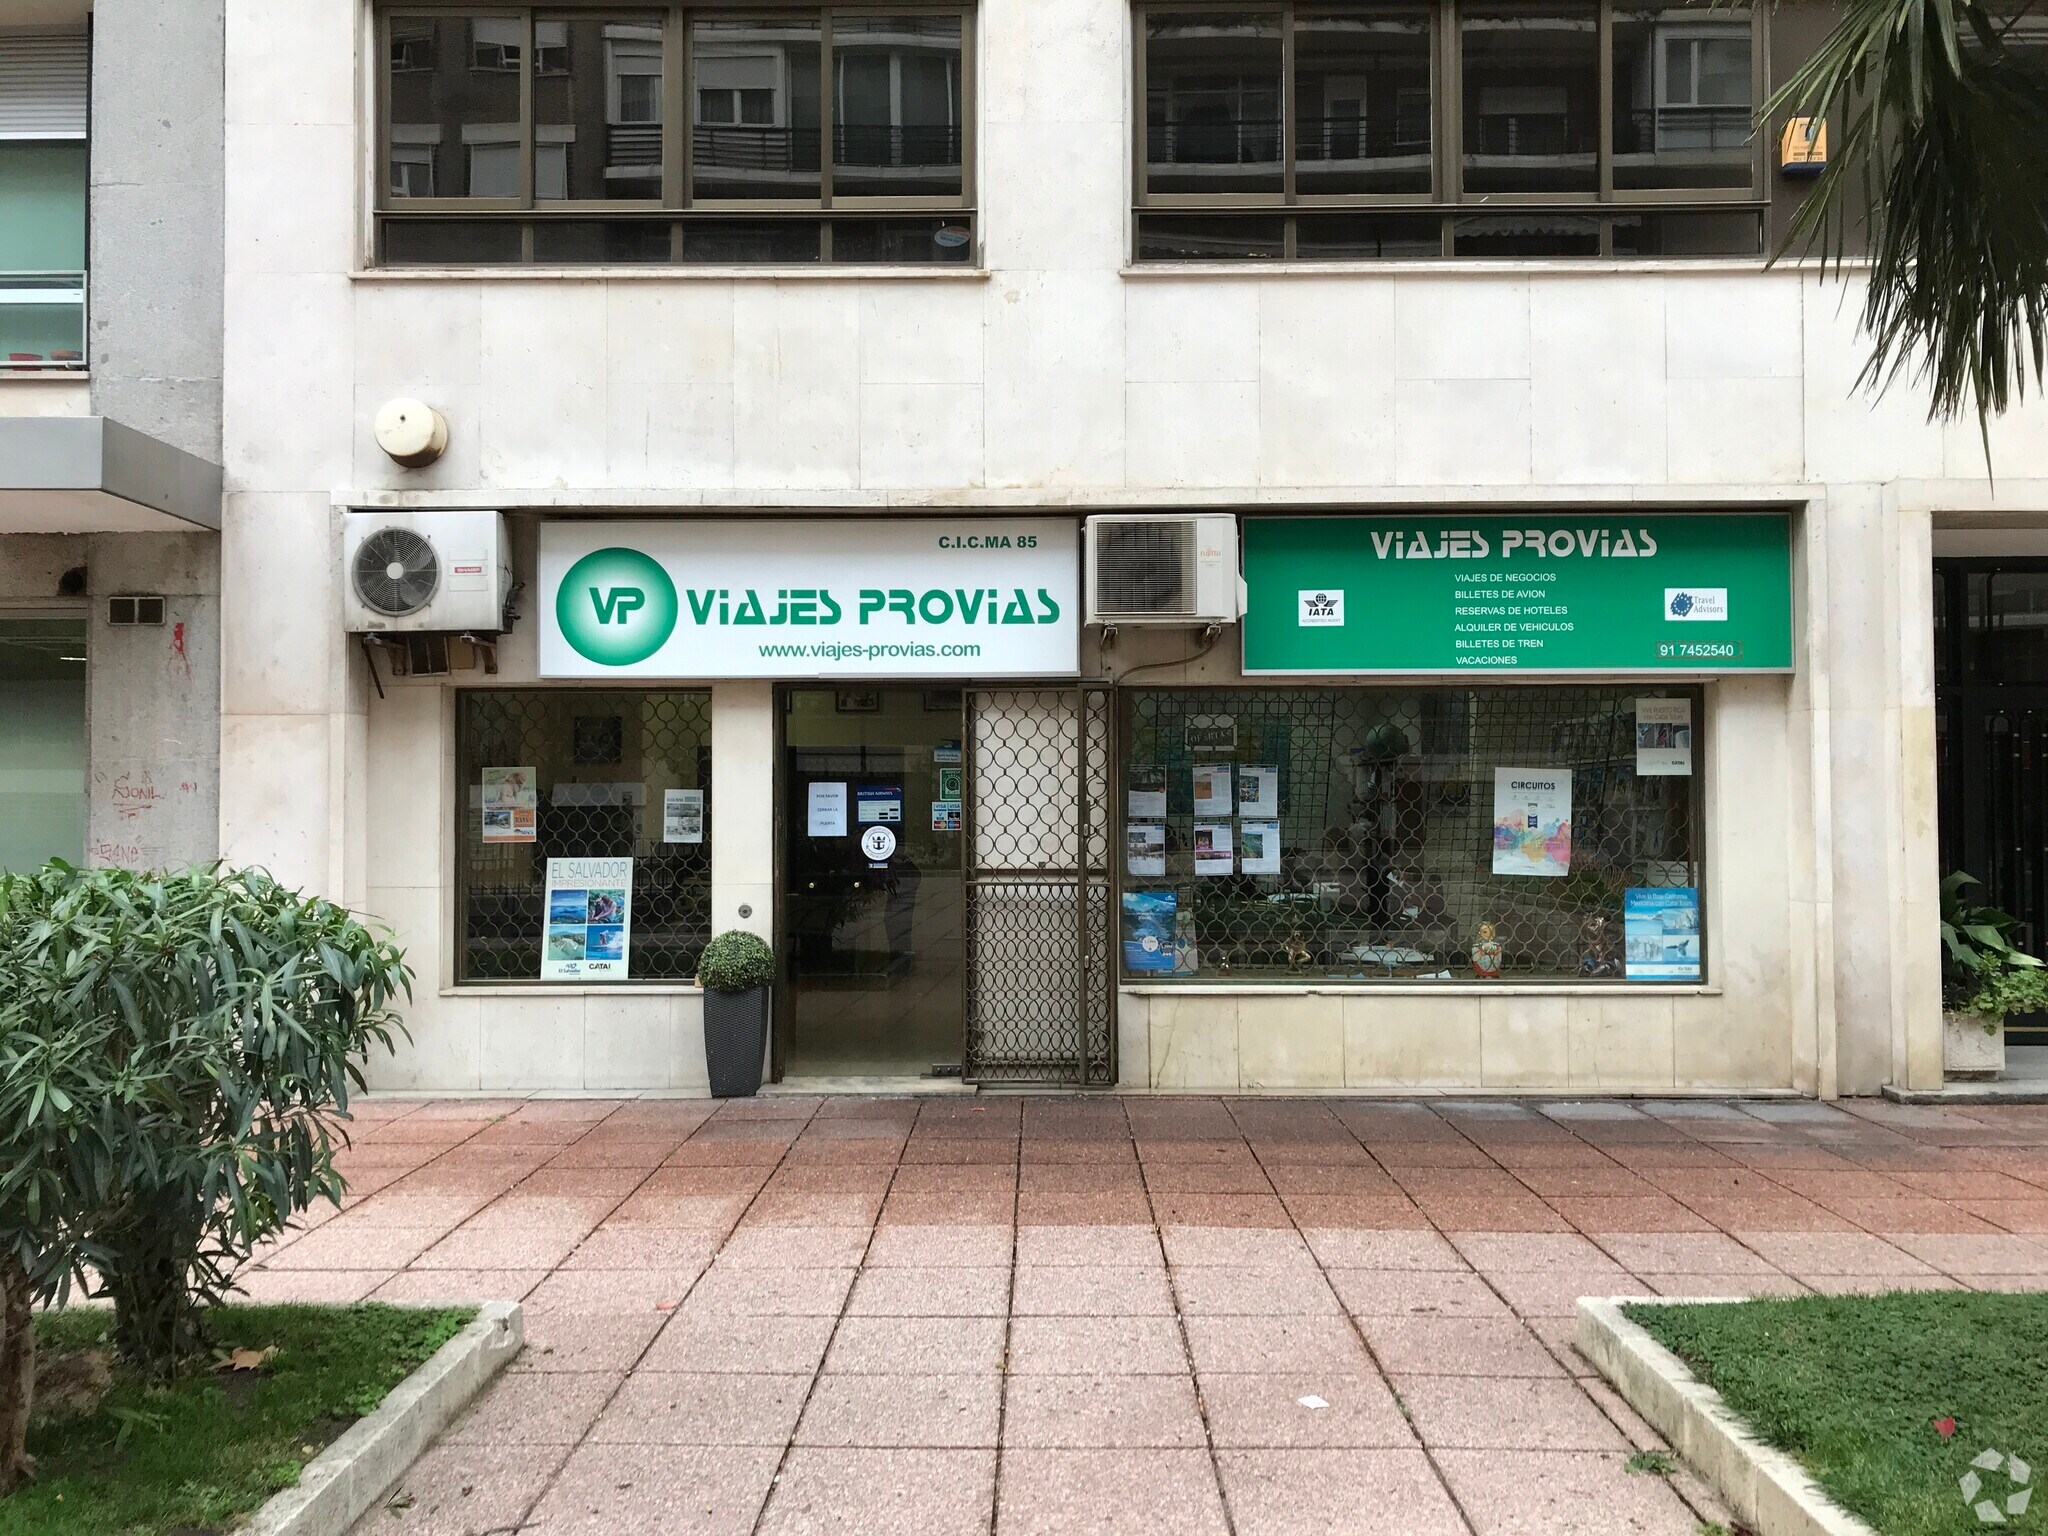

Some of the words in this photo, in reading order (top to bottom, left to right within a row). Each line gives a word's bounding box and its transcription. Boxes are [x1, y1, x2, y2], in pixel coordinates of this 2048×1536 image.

[938, 536, 1012, 549] C.I.C.MA
[1016, 536, 1038, 549] 85
[1454, 573, 1488, 582] VIAJES
[1490, 573, 1503, 582] DE
[1505, 573, 1557, 582] NEGOCIOS
[1454, 590, 1499, 599] BILLETES
[1501, 590, 1514, 599] DE
[1516, 590, 1546, 598] AVION
[1694, 595, 1715, 604] Travel
[589, 587, 646, 624] VP
[1693, 605, 1724, 613] Advisors
[1308, 608, 1334, 616] IATA
[1455, 606, 1506, 615] RESERVAS
[1508, 606, 1521, 615] DE
[1523, 606, 1568, 615] HOTELES
[1454, 623, 1501, 632] ALQUILER
[1504, 623, 1517, 632] DE
[1519, 622, 1575, 632] VEHICULOS
[1455, 639, 1500, 648] BILLETES
[1502, 639, 1515, 648] DE
[1518, 639, 1544, 648] TREN
[758, 641, 981, 661] www.viajes-provias.com
[1660, 644, 1675, 656] 91
[1679, 644, 1734, 656] 7452540
[1455, 656, 1518, 665] VACACIONES
[1511, 781, 1556, 790] CIRCUITOS
[552, 862, 565, 879] EL
[568, 861, 628, 878] SALVADOR
[551, 879, 627, 887] IMPRESIONANTE
